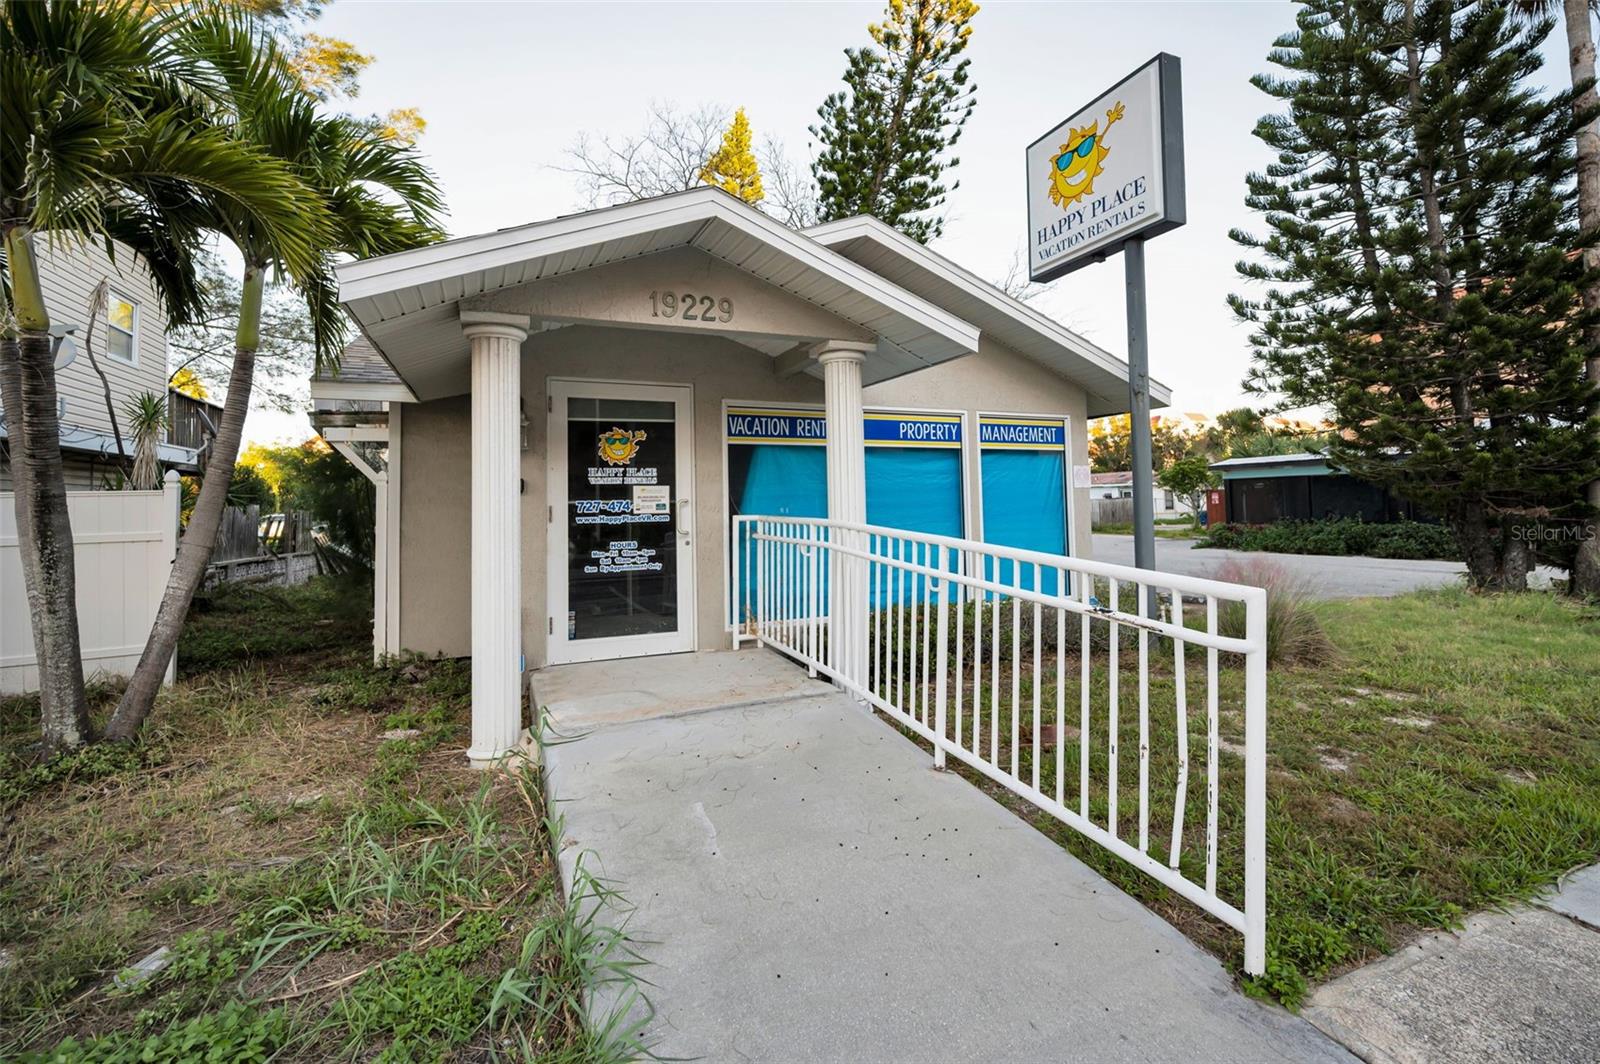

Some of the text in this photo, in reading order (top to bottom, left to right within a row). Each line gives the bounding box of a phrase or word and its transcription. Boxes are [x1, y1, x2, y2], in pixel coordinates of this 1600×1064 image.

[1037, 176, 1146, 246] HAPPY PLACE
[1038, 201, 1146, 261] VACATION RENTALS
[648, 290, 734, 324] 19229
[729, 416, 1057, 443] VACATION RENT PROPERTY MANAGEMENT
[575, 500, 633, 513] 727-474
[575, 513, 670, 525] www.HappyPlaceVR.com
[609, 541, 638, 550] HOURS
